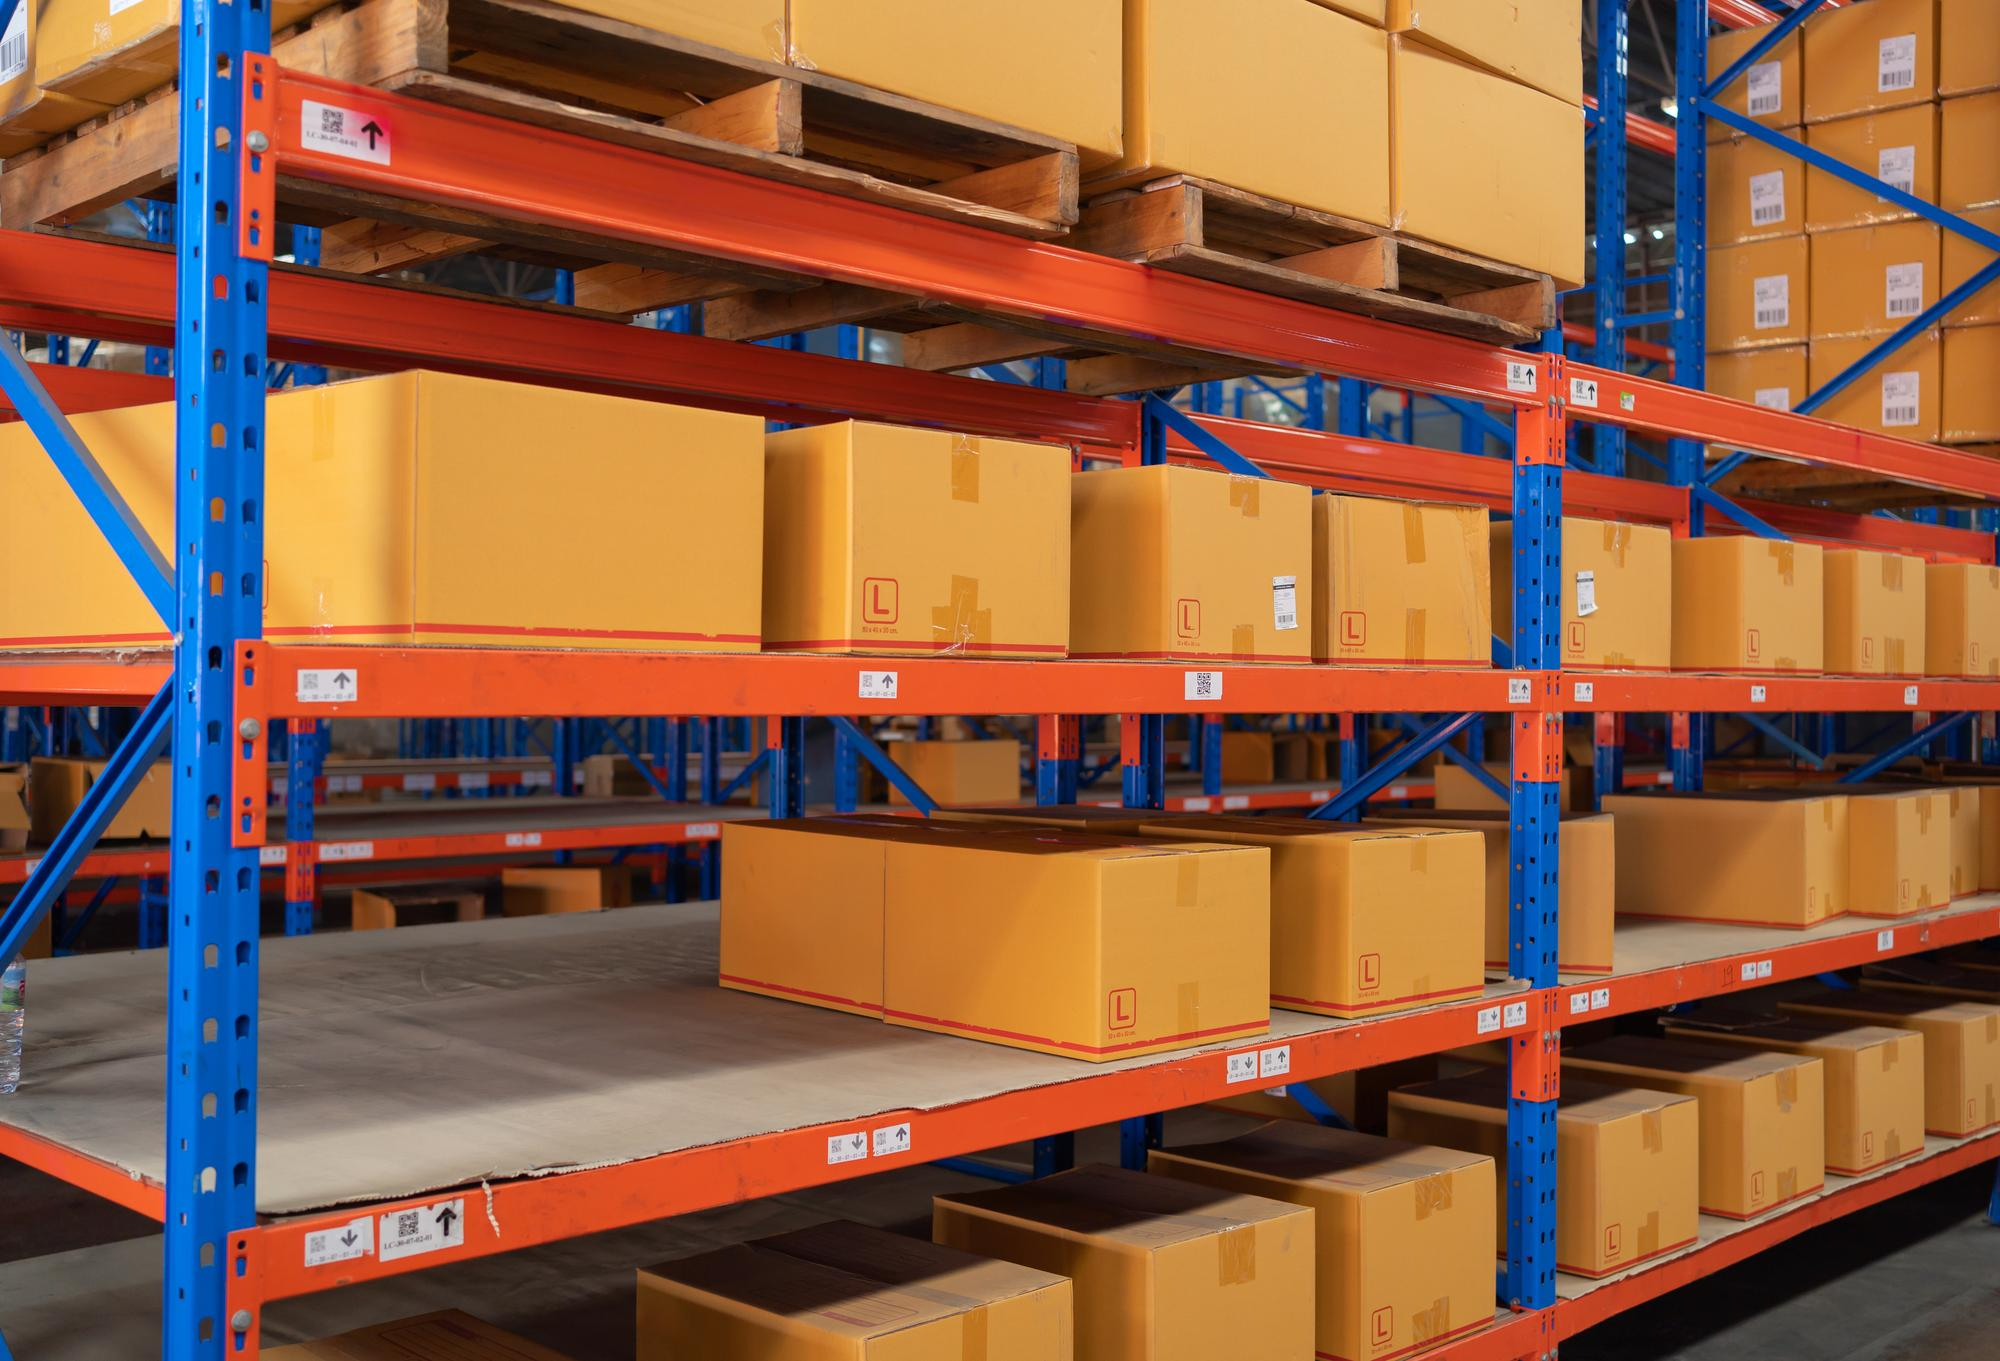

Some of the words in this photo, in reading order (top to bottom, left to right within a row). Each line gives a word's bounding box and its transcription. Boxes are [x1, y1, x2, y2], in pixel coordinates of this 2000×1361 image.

[873, 584, 890, 615] L
[1183, 604, 1196, 631] L
[1347, 616, 1360, 640] L
[1572, 626, 1581, 647] L
[1750, 633, 1757, 652] L
[1364, 959, 1375, 983] L
[1116, 995, 1130, 1021] L
[1755, 1176, 1761, 1195] L
[1609, 1231, 1617, 1250] L
[1378, 1314, 1388, 1337] L
